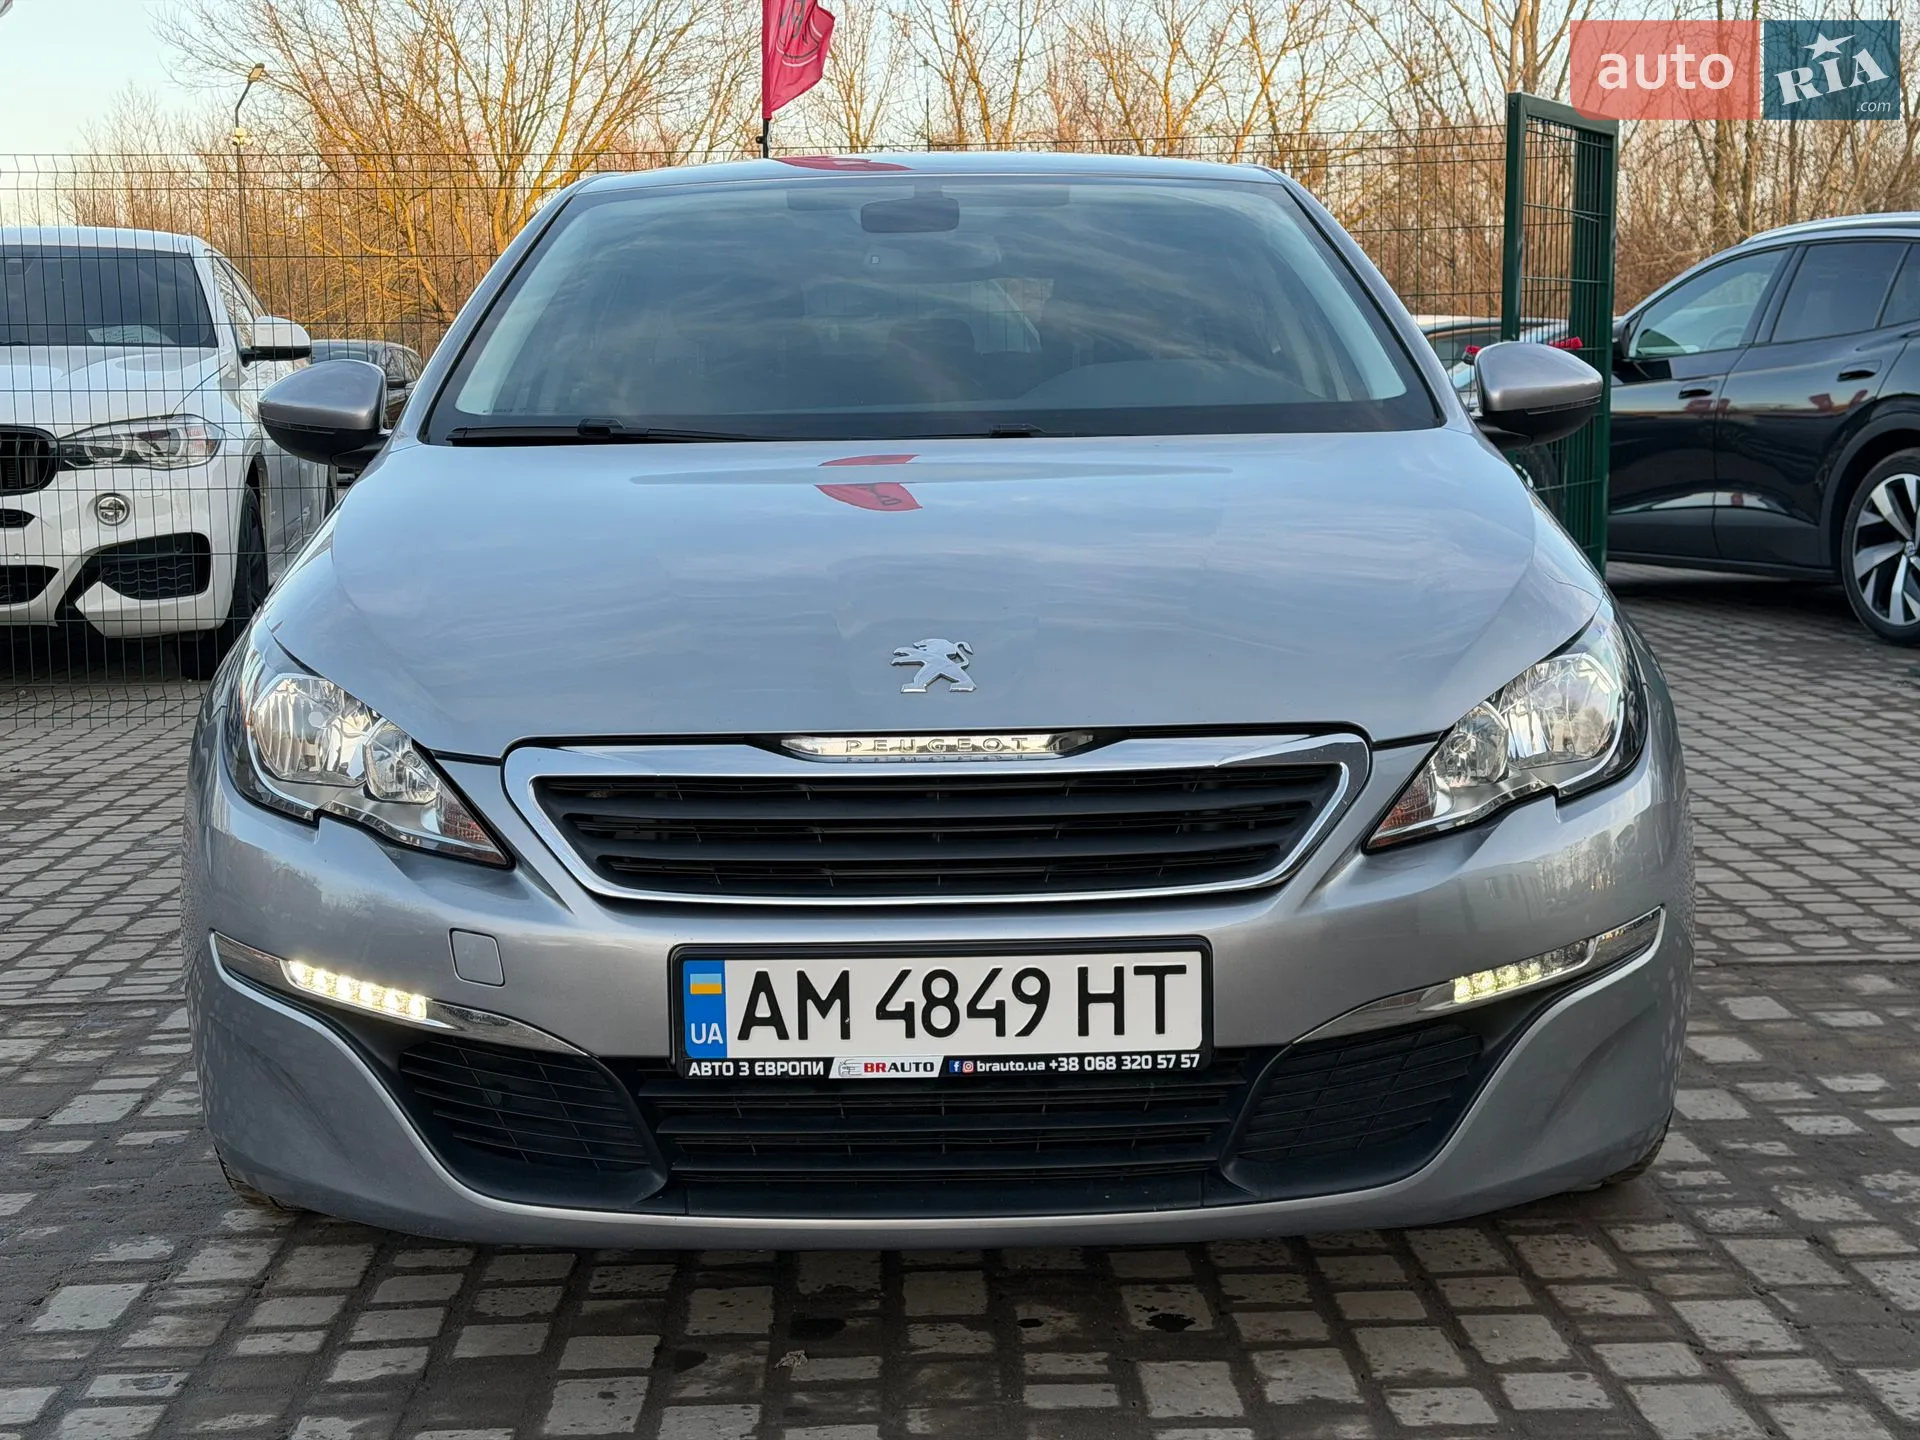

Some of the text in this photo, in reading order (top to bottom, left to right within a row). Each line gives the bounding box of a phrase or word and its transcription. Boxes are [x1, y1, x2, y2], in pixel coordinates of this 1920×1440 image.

[845, 737, 1029, 754] PEUGEOT
[737, 964, 1188, 1041] AM 4849 HT
[690, 1022, 724, 1046] UA
[688, 1061, 735, 1077] АВТО
[754, 1060, 825, 1076] ЄВРОПИ
[863, 1061, 935, 1073] BRAUTO
[976, 1053, 1200, 1072] brauto.ua +38 068 320 57 57
